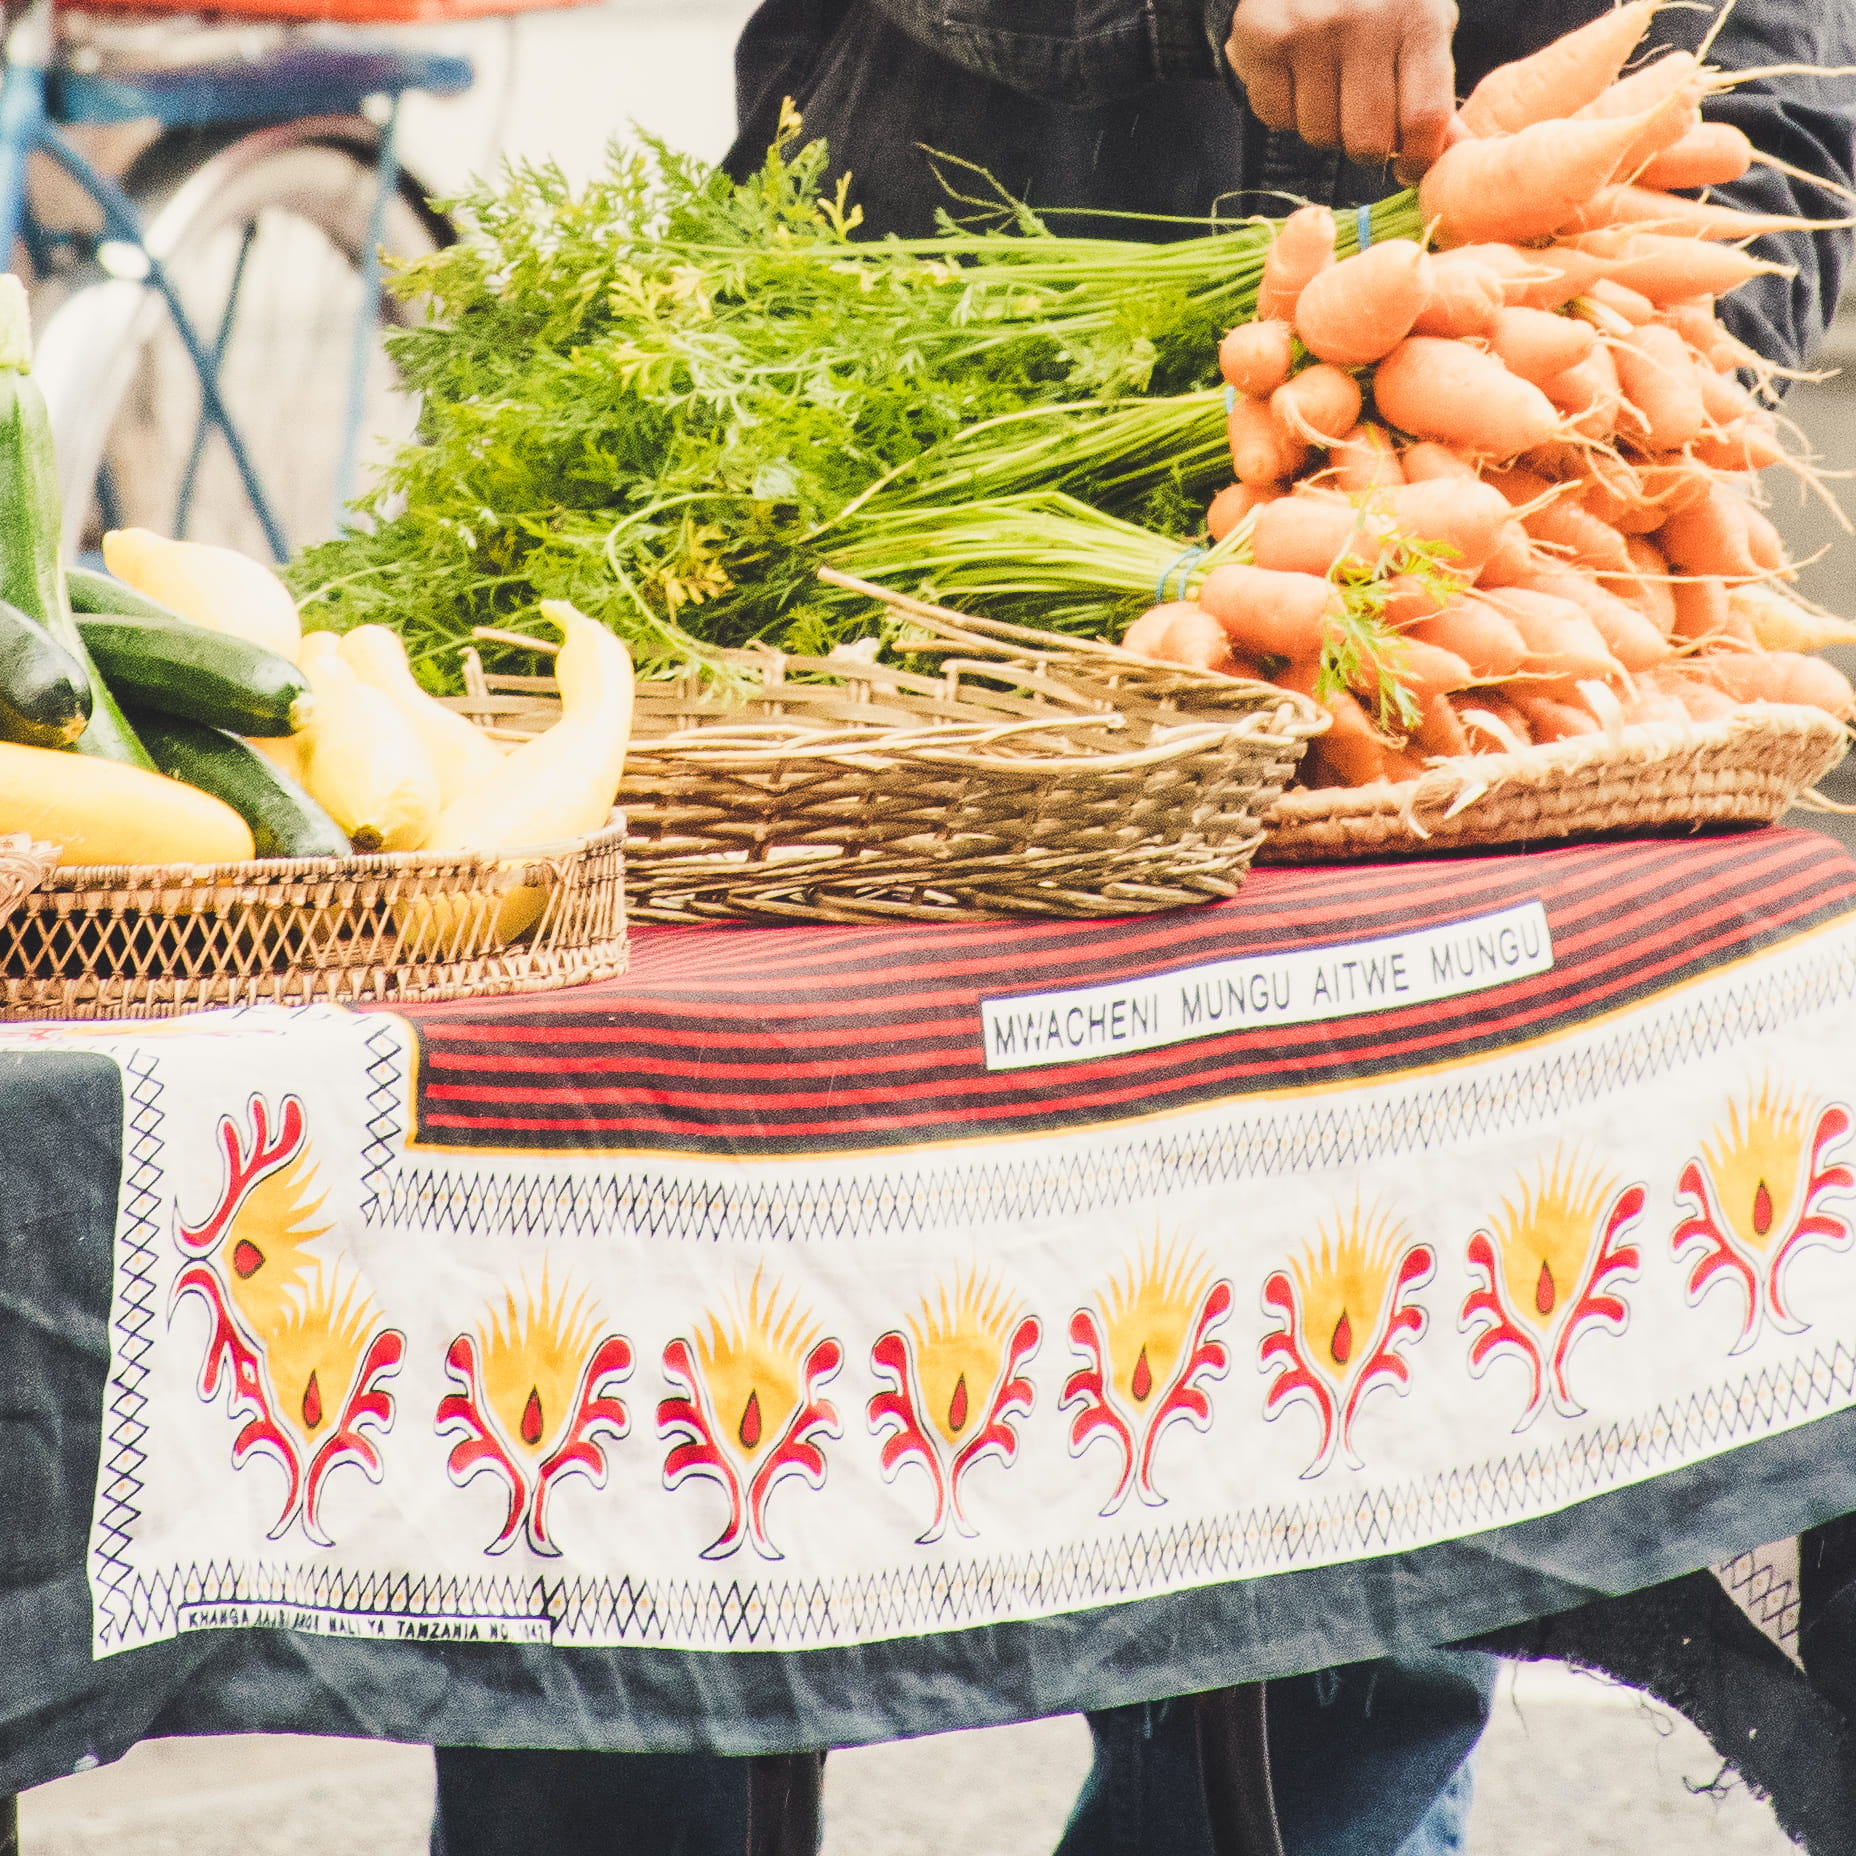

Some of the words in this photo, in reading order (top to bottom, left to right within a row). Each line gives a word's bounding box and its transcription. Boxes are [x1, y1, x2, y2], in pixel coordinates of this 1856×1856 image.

[994, 993, 1158, 1055] MWACHENI
[1181, 970, 1291, 1027] MUNGU
[1313, 952, 1409, 1006] AITWE
[1430, 920, 1540, 984] MUNGU
[367, 1619, 386, 1637] YA
[397, 1619, 480, 1641] TANZANIA
